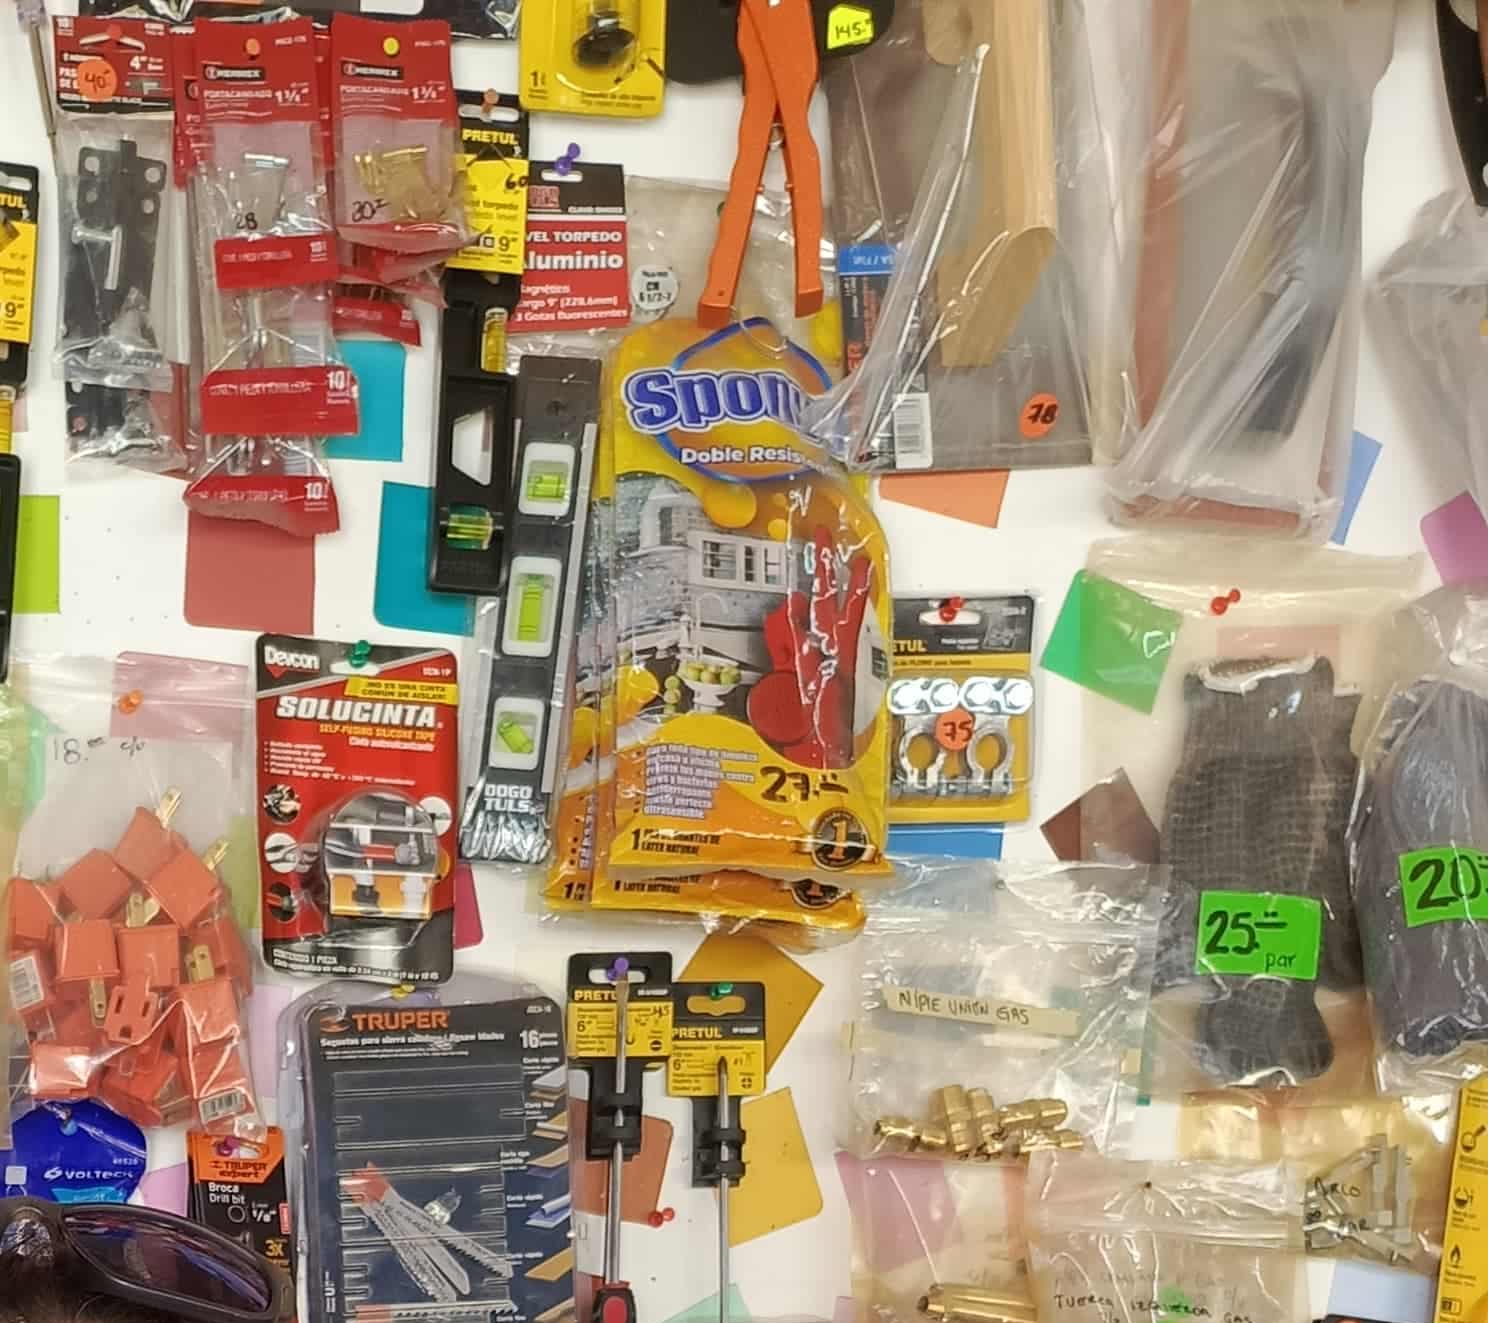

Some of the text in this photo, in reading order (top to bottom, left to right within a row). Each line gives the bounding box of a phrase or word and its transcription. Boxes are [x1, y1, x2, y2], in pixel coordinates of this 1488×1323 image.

[462, 129, 519, 145] PRETUL
[235, 213, 257, 230] 28
[554, 231, 622, 243] TORPEDO
[525, 252, 623, 270] luminio
[1023, 399, 1059, 425] 78
[682, 447, 744, 464] Doble
[276, 696, 436, 728] SOLUCINTA
[944, 720, 973, 741] 75
[485, 784, 533, 799] DOGO
[1264, 950, 1297, 970] par
[352, 1010, 449, 1032] TRUPER
[520, 1030, 538, 1048] 16
[671, 1026, 722, 1038] PRETUL
[219, 1169, 260, 1179] expert
[208, 1182, 239, 1194] Broca
[208, 1192, 230, 1204] Drill
